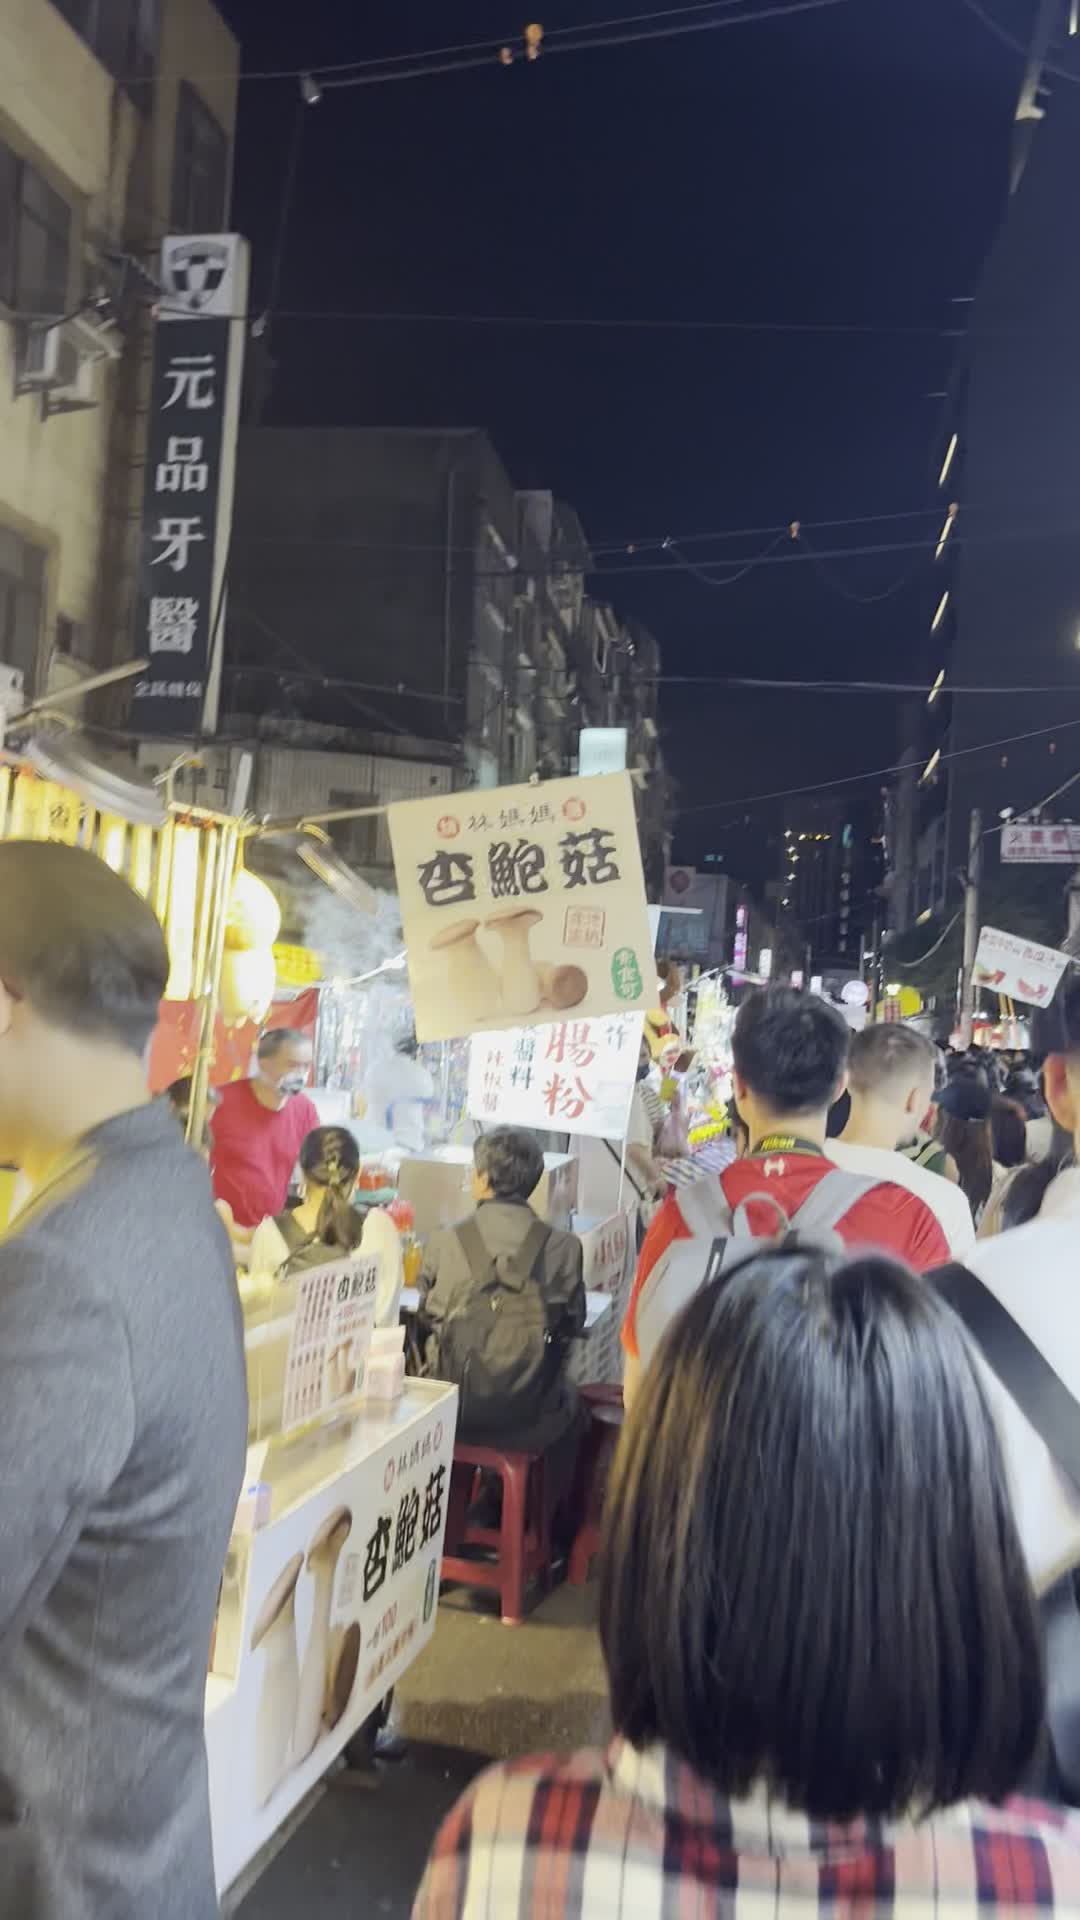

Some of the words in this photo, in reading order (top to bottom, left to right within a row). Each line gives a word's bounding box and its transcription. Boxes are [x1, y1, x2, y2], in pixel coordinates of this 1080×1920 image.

[146, 354, 217, 654] 元品牙醫
[416, 827, 621, 907] 杏鮑菇
[541, 1022, 600, 1119] 腸粉
[363, 1463, 446, 1603] 杏鮑菇
